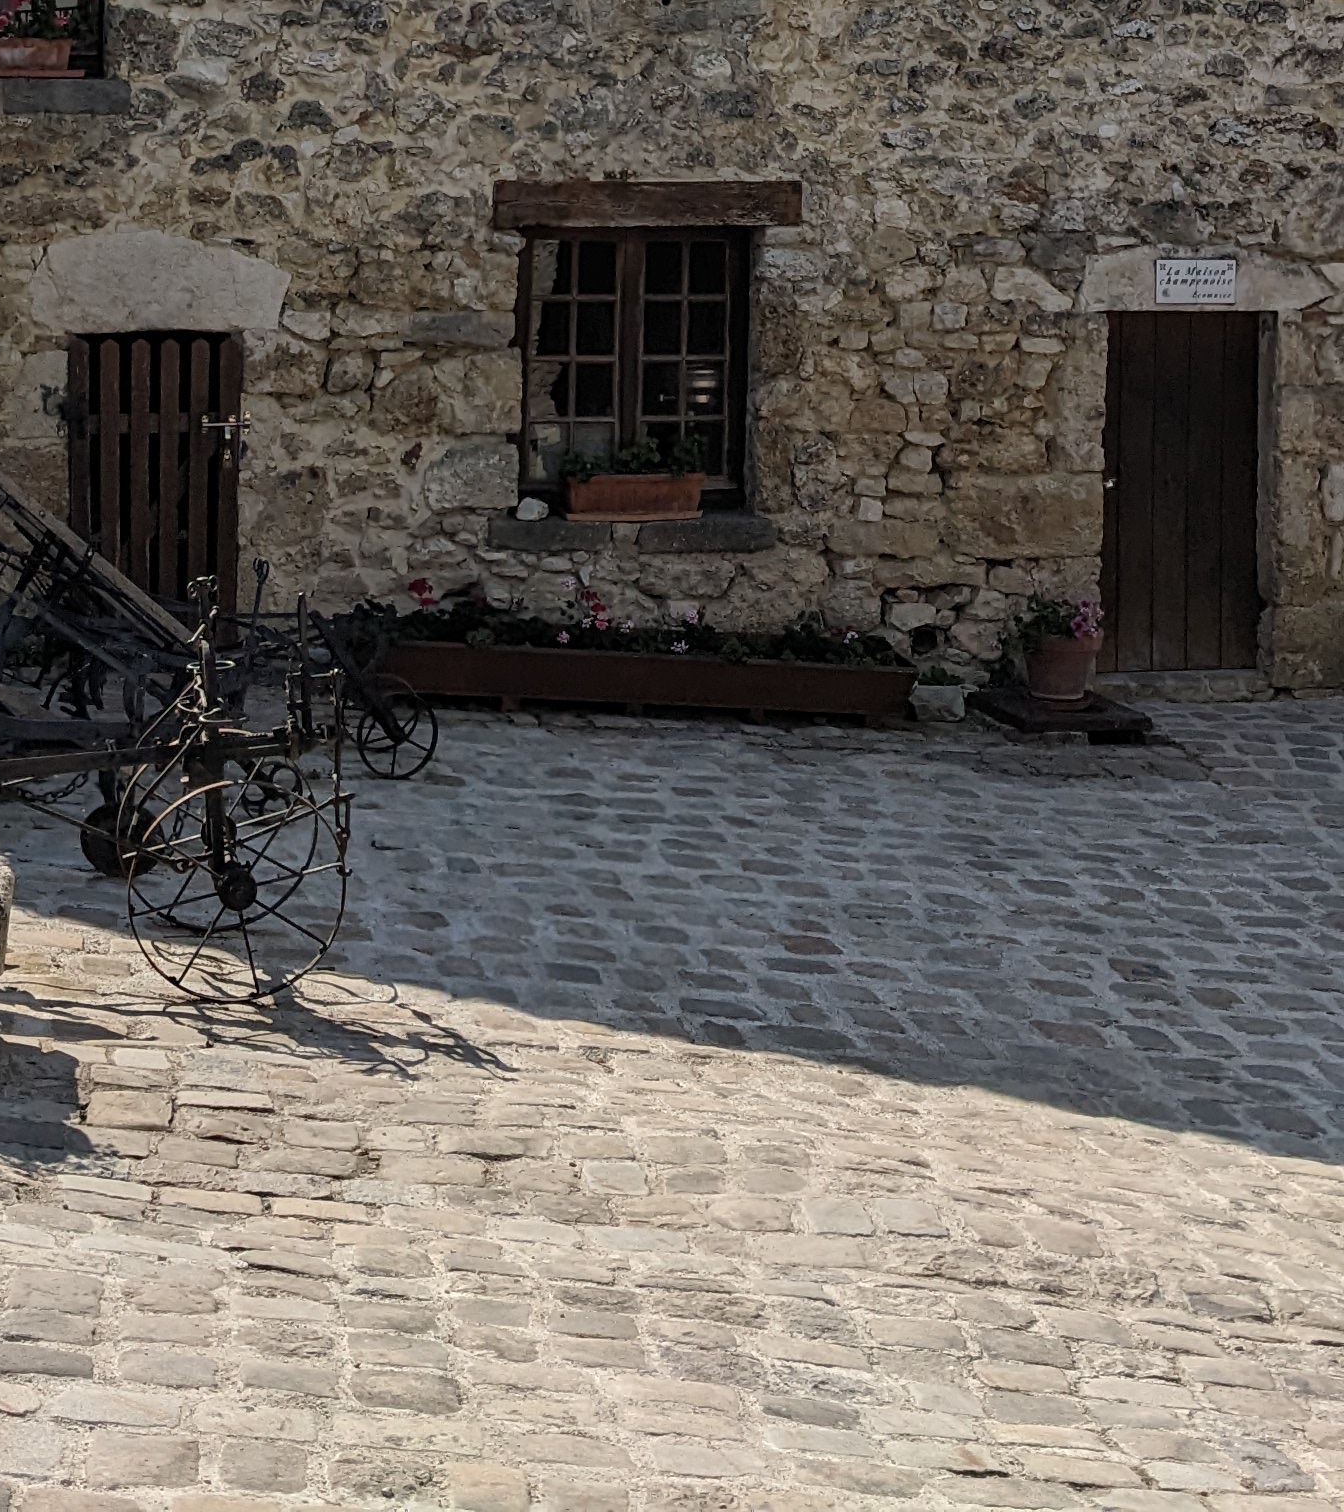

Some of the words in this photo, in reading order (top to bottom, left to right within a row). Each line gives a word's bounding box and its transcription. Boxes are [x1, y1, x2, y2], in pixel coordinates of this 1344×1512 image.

[1166, 266, 1181, 276] La
[1185, 266, 1227, 276] Maison
[1159, 276, 1233, 287] champenoise
